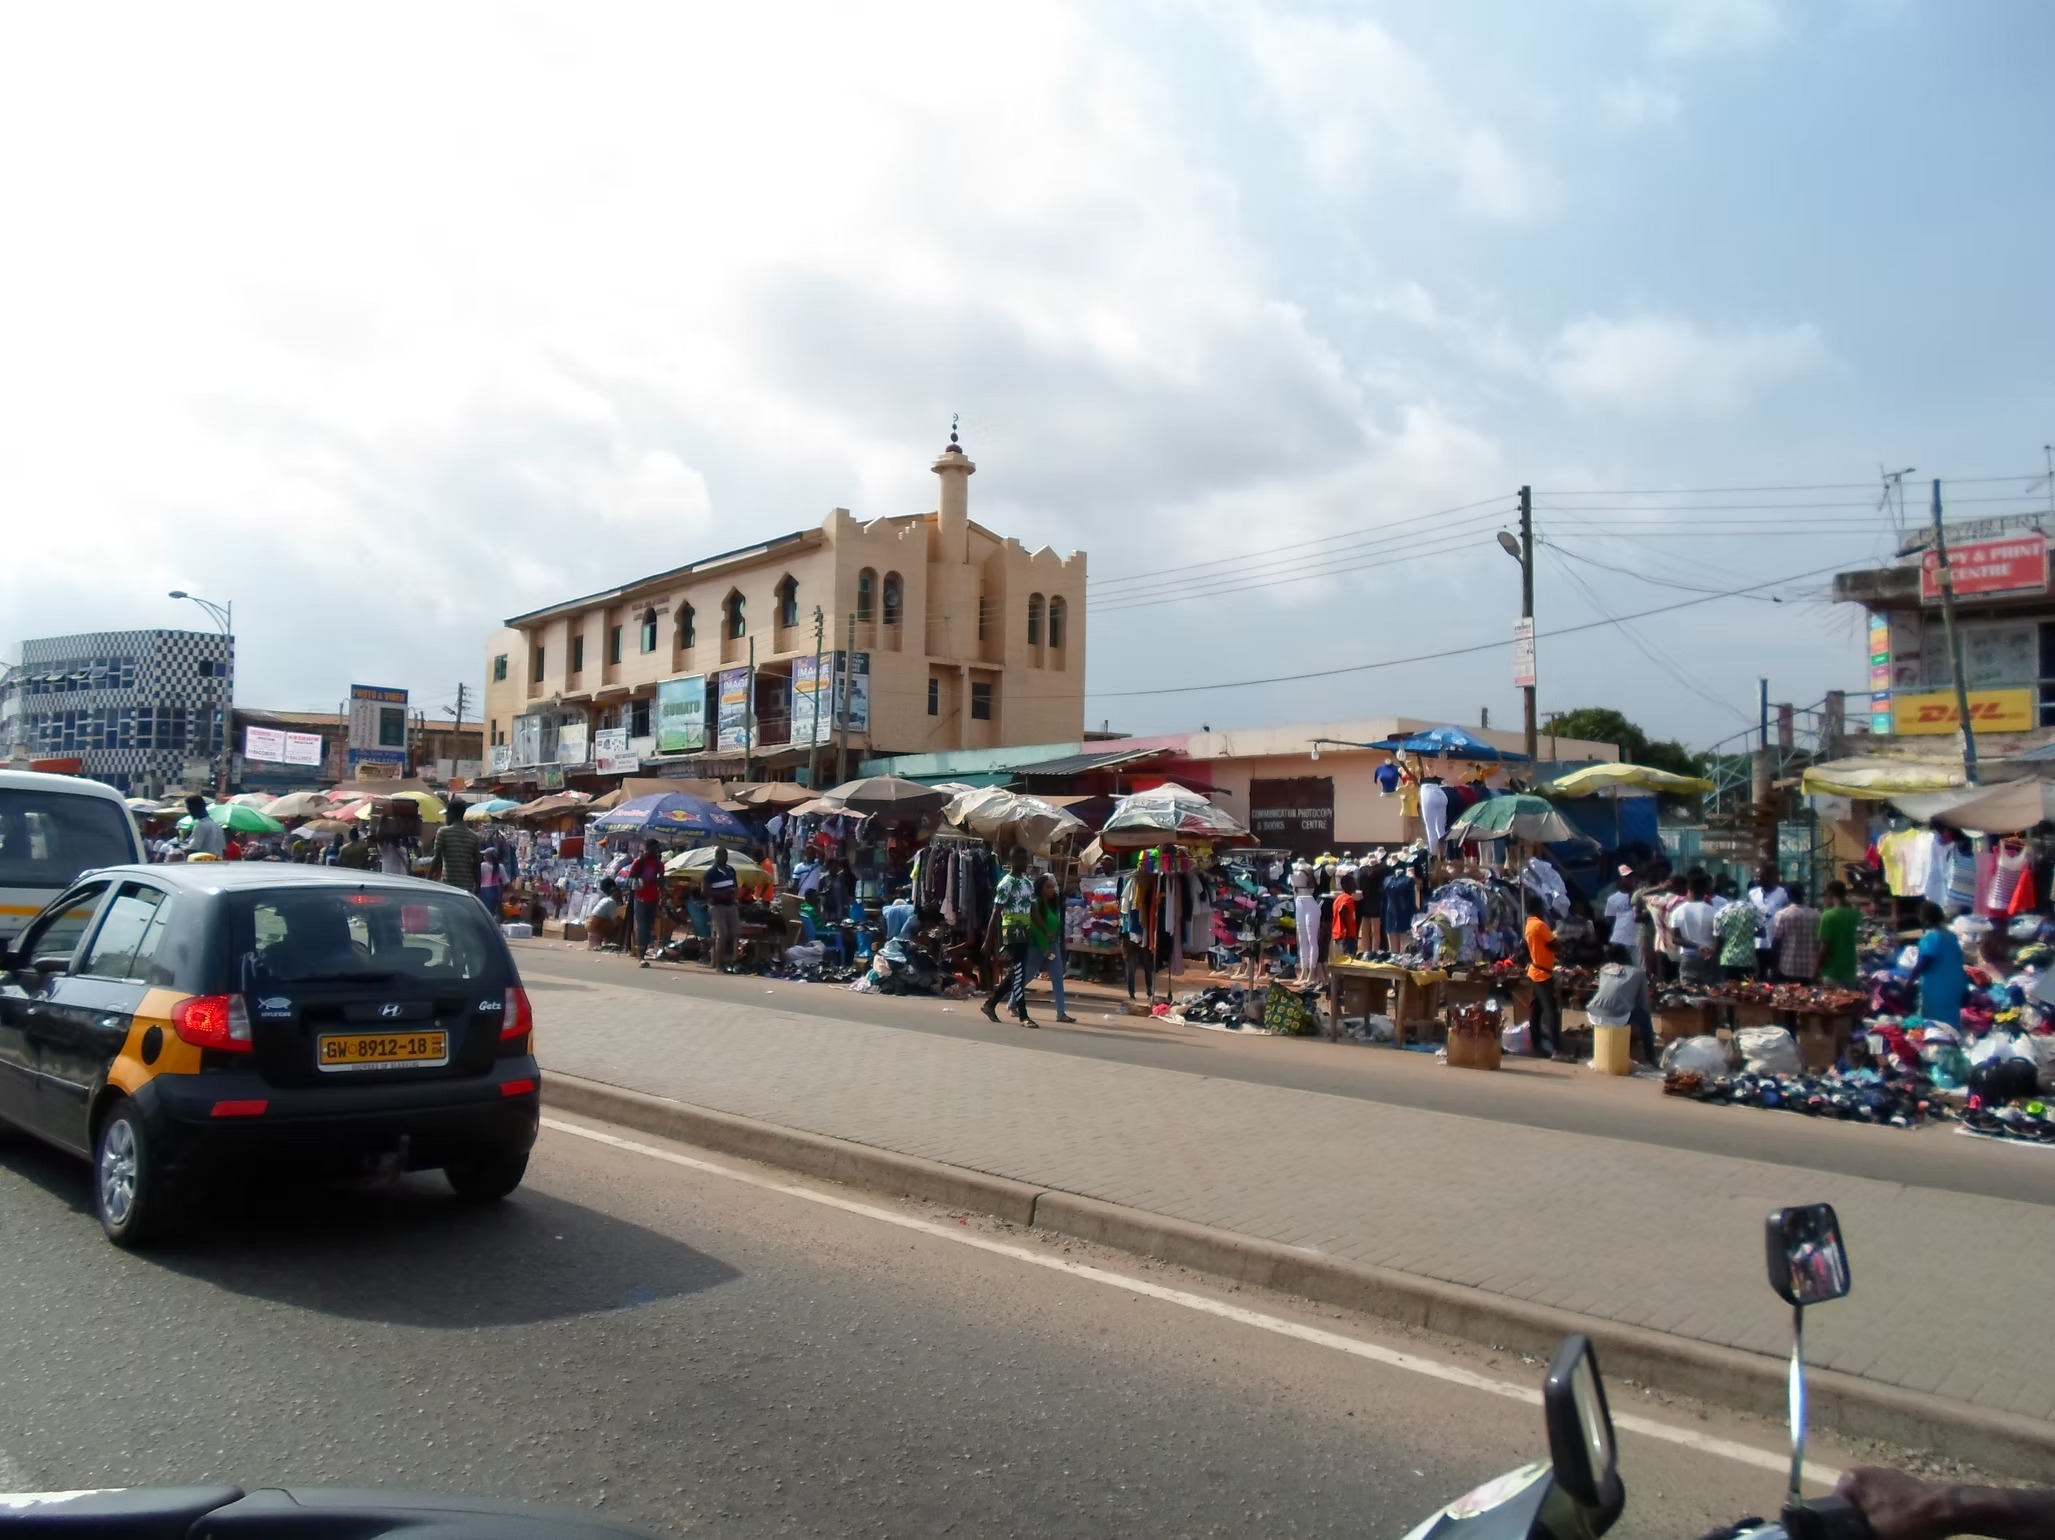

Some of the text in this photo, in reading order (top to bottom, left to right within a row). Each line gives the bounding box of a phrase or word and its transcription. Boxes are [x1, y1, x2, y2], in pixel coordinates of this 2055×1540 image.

[1924, 543, 2041, 569] CPY & PRINT
[1918, 702, 2008, 723] DHL
[1297, 807, 1333, 818] PHOTOCOPY
[1301, 820, 1327, 830] CENTRE
[479, 1000, 502, 1011] Getz
[326, 1037, 427, 1059] GW 8912-18
